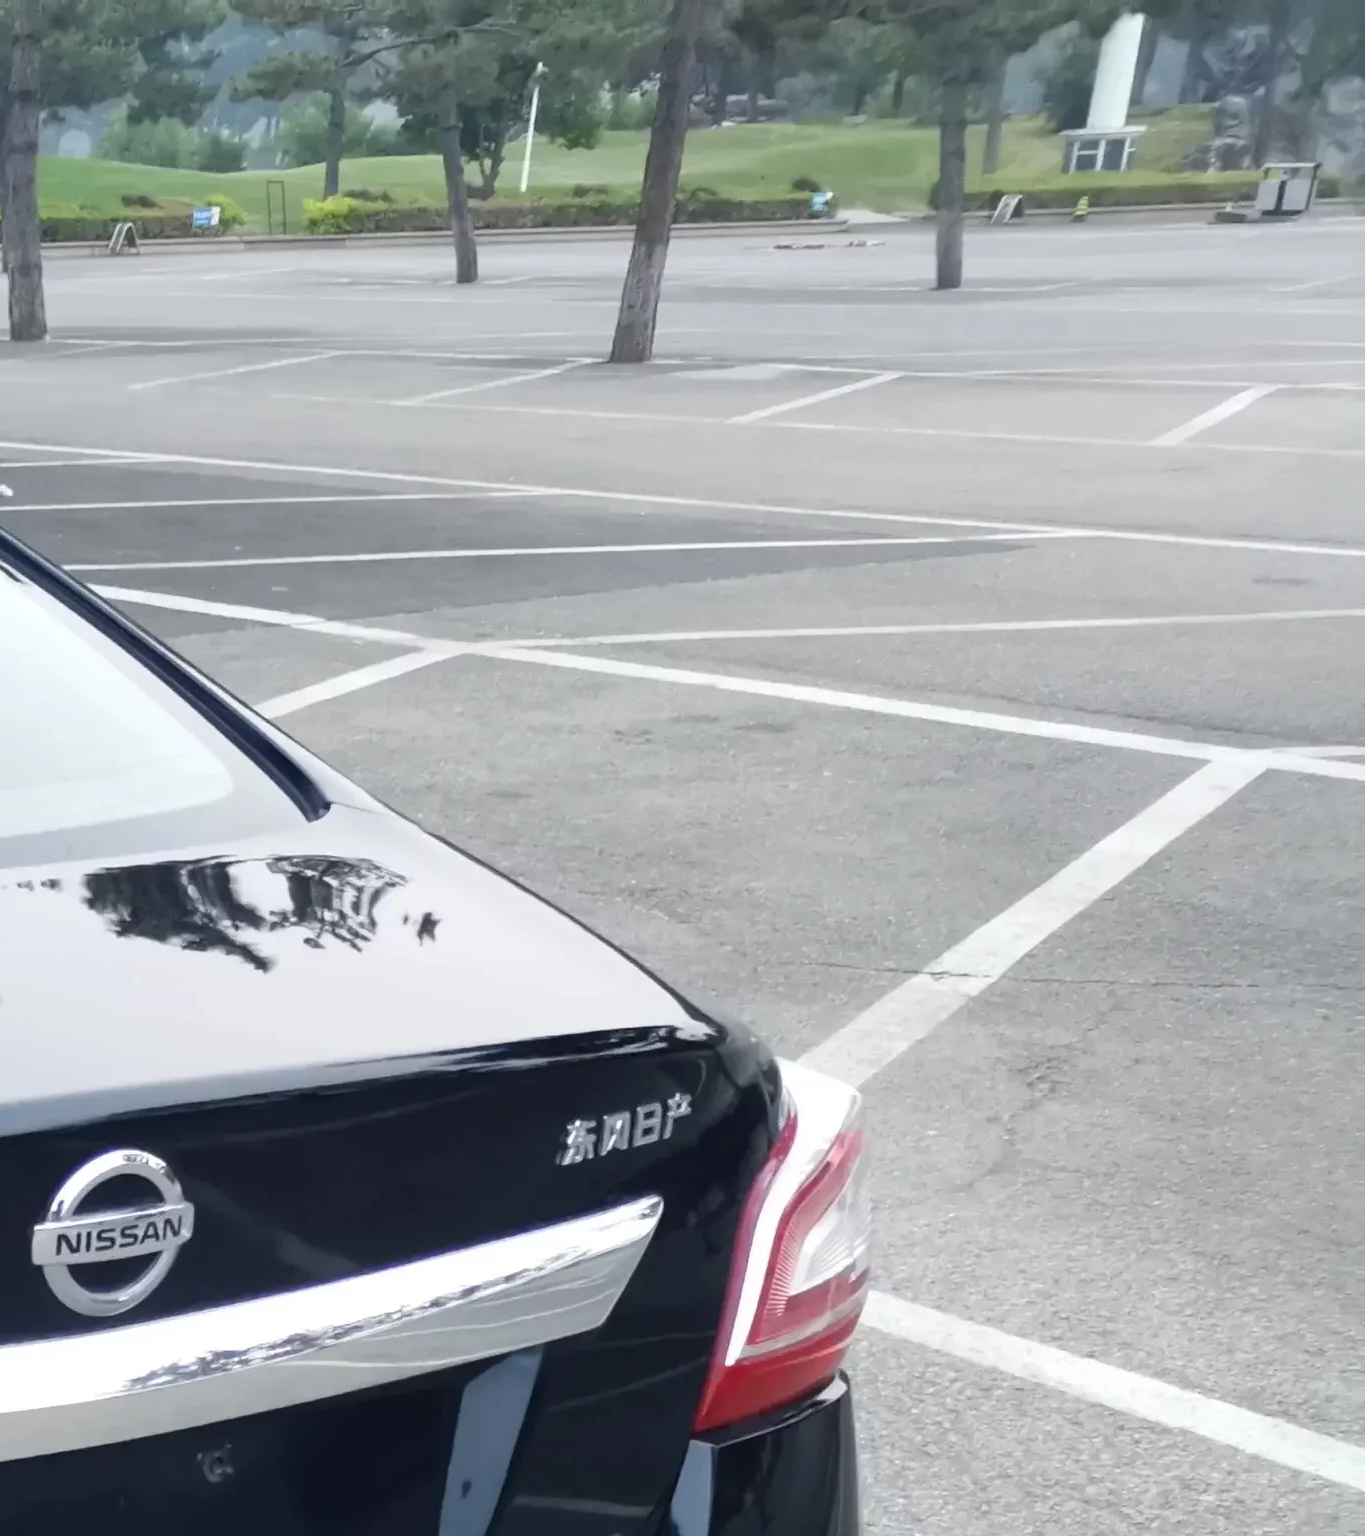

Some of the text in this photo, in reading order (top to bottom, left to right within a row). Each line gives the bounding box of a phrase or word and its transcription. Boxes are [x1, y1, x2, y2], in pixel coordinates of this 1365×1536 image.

[558, 1091, 693, 1166] 东风日产
[55, 1214, 183, 1257] NISSAN
